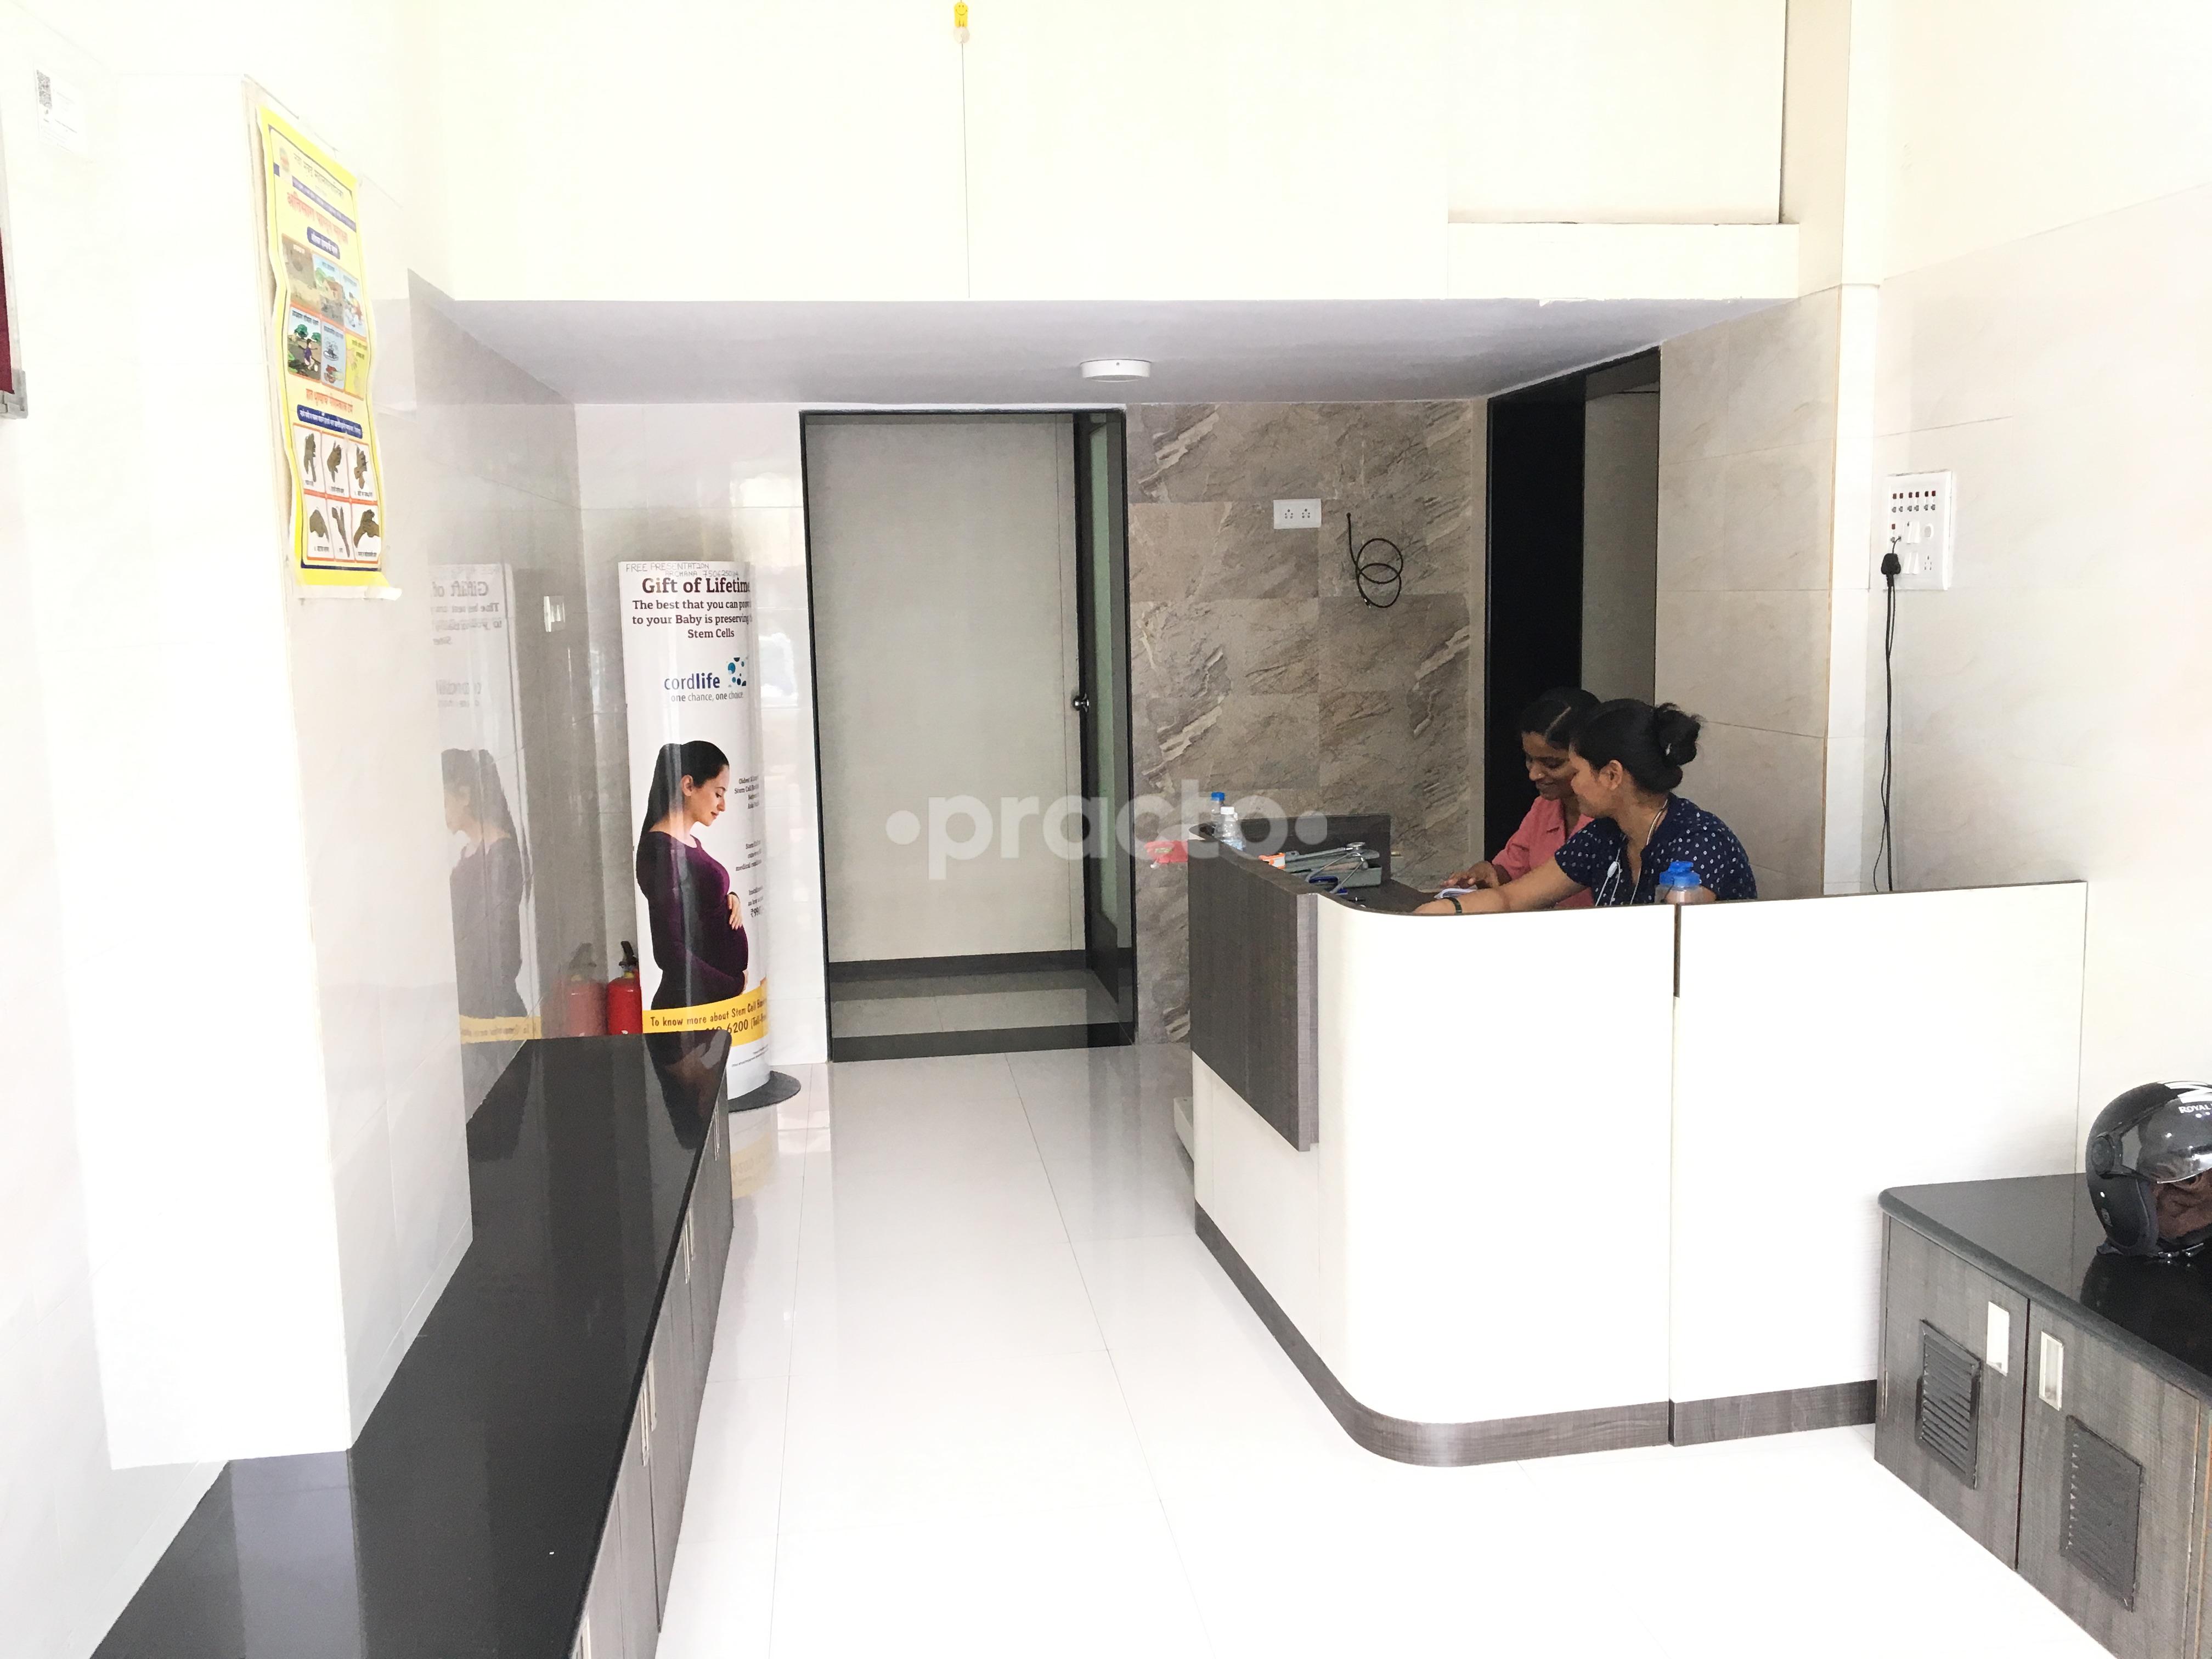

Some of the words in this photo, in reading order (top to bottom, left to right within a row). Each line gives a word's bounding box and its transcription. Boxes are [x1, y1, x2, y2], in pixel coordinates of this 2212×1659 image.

[626, 563, 647, 572] FREE
[651, 562, 709, 571] PRESENTATION
[642, 578, 678, 594] Gift
[683, 577, 702, 594] of
[633, 600, 653, 610] The
[656, 600, 679, 610] best
[682, 600, 704, 609] that
[707, 601, 724, 611] you
[726, 601, 738, 609] can
[632, 616, 644, 624] to
[646, 616, 672, 627] your
[675, 614, 702, 625] Baby
[704, 614, 713, 623] is
[715, 614, 749, 625] preserving
[687, 629, 714, 638] Stem
[716, 628, 735, 637] Cells
[664, 673, 721, 690] cordlife
[688, 693, 714, 702] chance,
[650, 1017, 659, 1026] To
[663, 1016, 683, 1026] know
[687, 1016, 707, 1025] more
[710, 1012, 729, 1023] about
[731, 1008, 746, 1018] Stem
[747, 1001, 756, 1013] Cell
[2178, 1104, 2211, 1114] ROYAL
